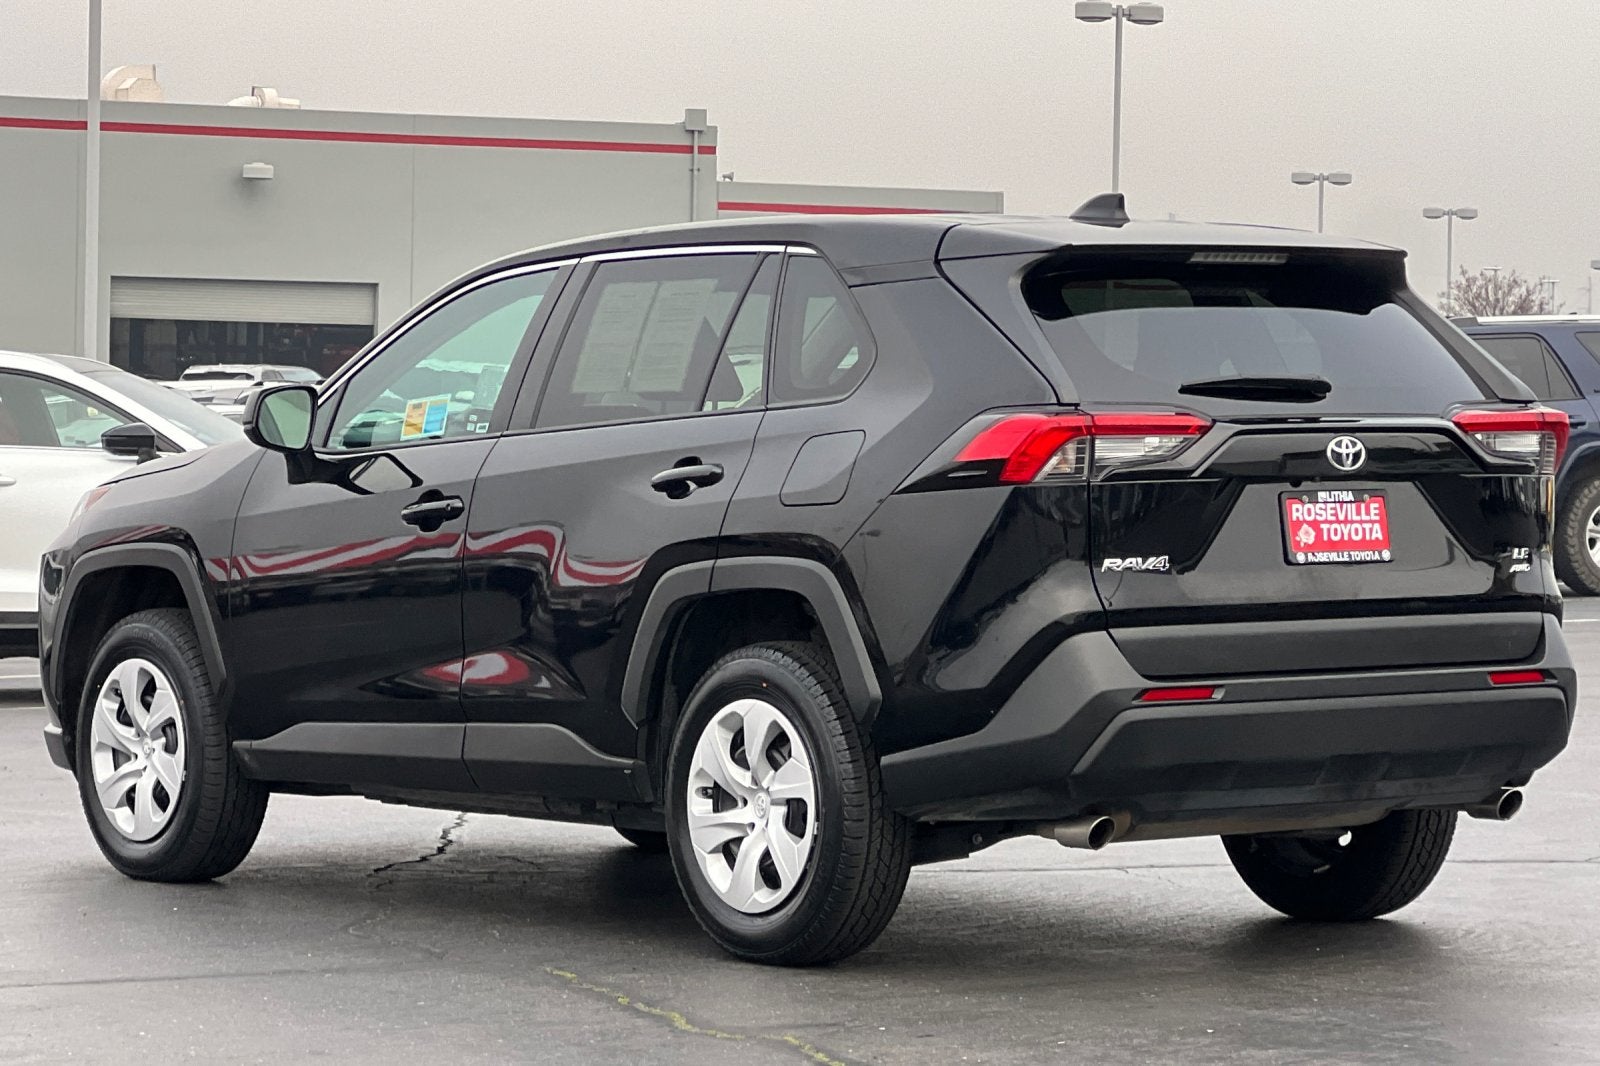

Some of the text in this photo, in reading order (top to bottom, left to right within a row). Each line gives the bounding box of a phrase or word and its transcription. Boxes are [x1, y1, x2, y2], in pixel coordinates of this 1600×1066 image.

[1326, 491, 1354, 502] LITHIA
[1292, 503, 1380, 521] ROSEVILLE
[1320, 523, 1383, 542] TOYOTA
[1350, 550, 1380, 561] TOYOTA
[1101, 556, 1170, 573] RAV4
